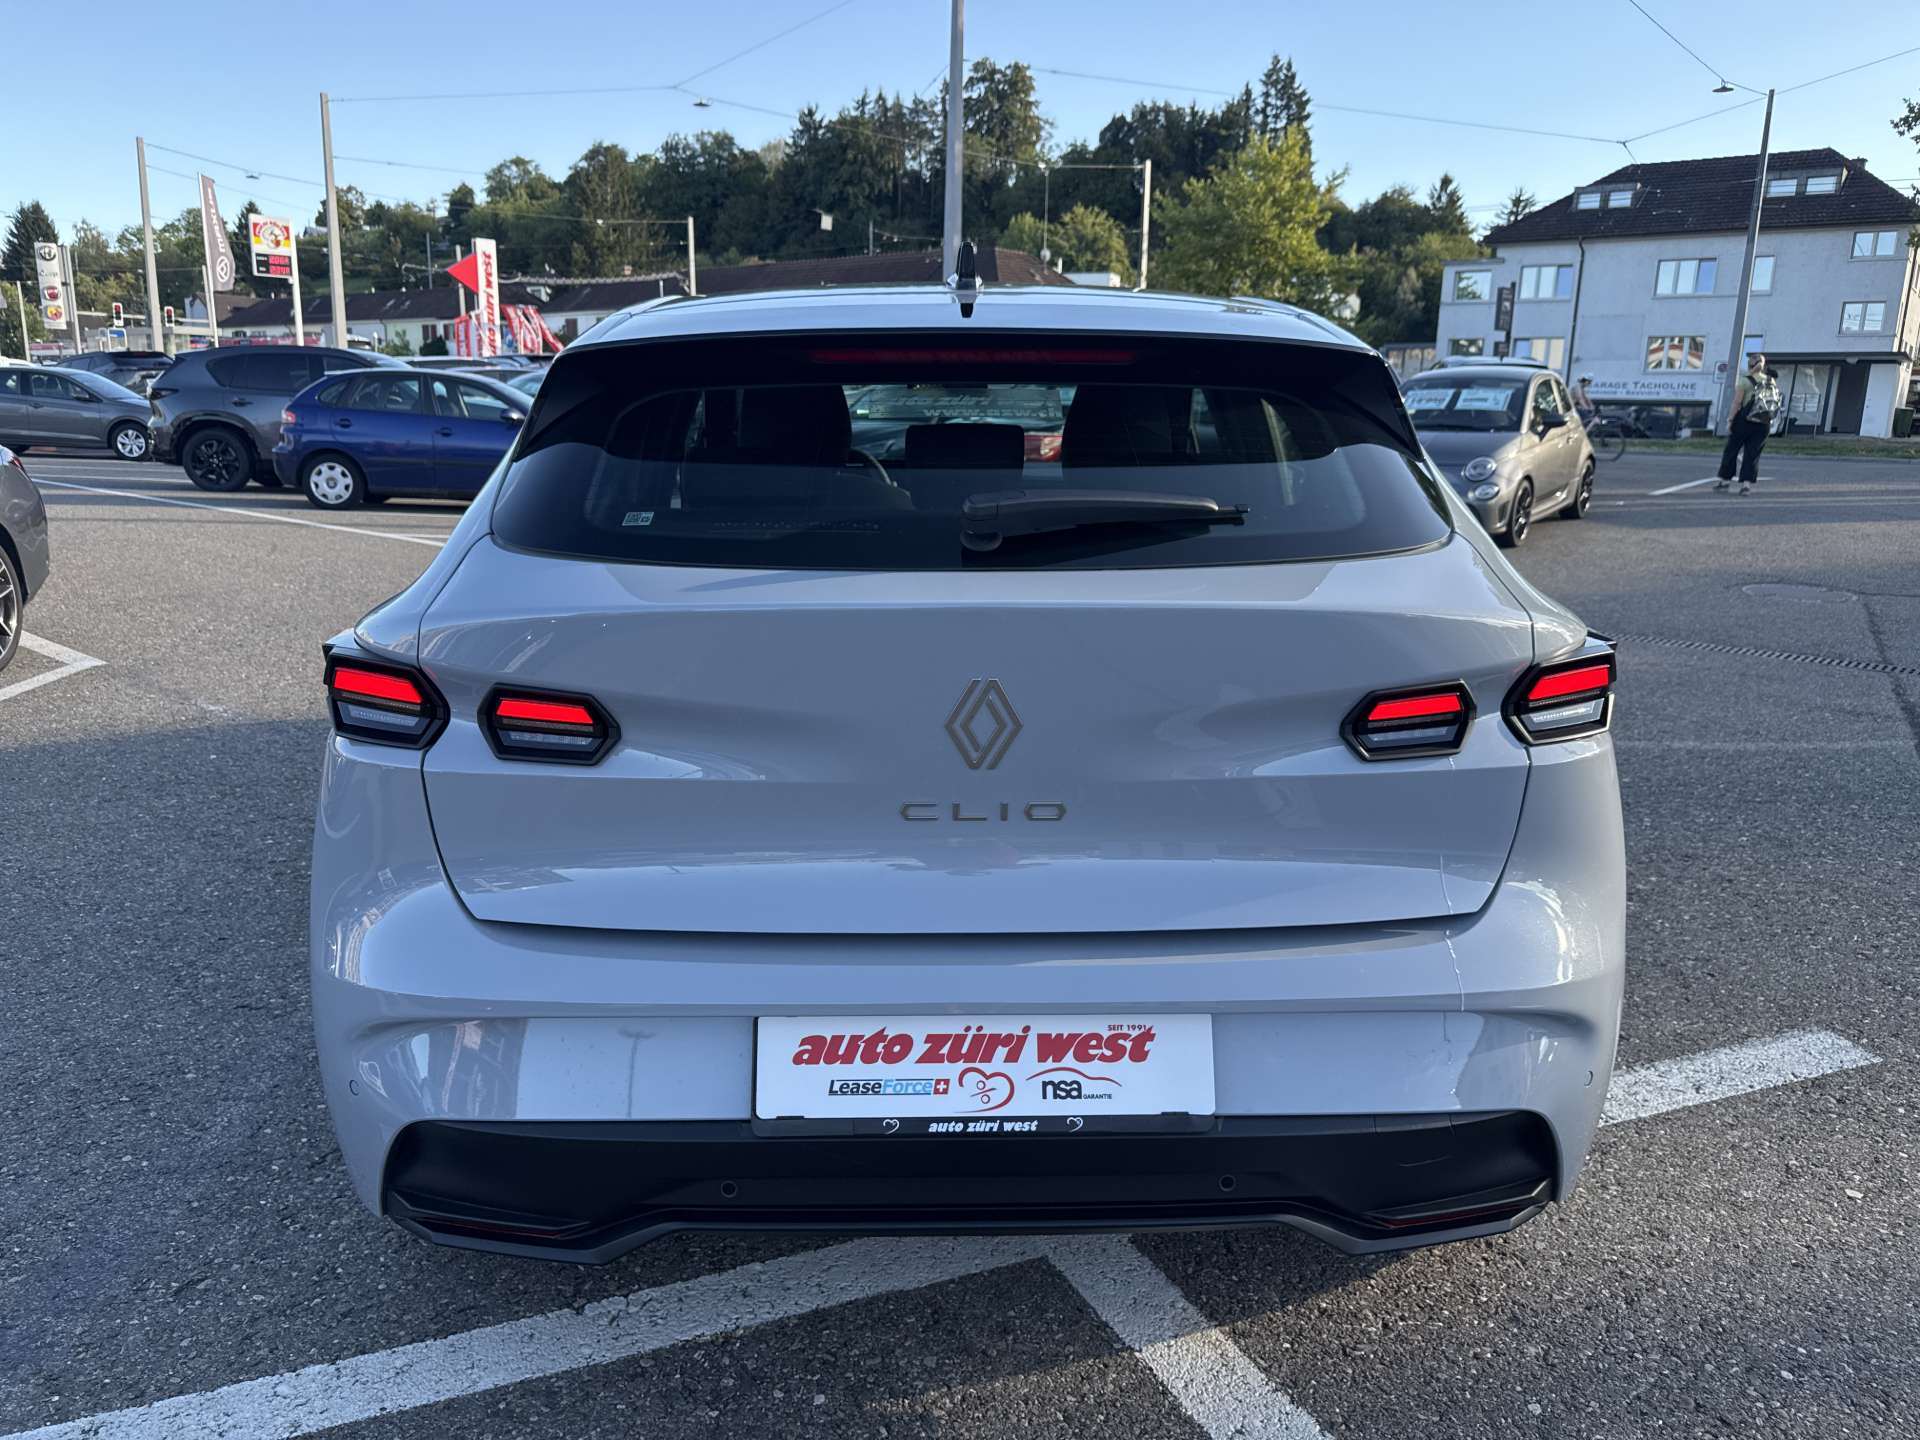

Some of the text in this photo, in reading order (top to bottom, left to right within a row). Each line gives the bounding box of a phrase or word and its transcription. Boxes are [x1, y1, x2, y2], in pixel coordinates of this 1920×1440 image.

[483, 251, 493, 289] west
[487, 327, 497, 357] uto
[1590, 381, 1697, 390] ARAGE TACHOLINE
[900, 802, 1067, 821] CLIO
[1107, 1024, 1148, 1032] SEIT 1991
[792, 1024, 1157, 1066] auto züri west
[829, 1079, 933, 1096] LeaseForce
[1041, 1080, 1083, 1100] nsa
[928, 1119, 1038, 1133] auto züri west
